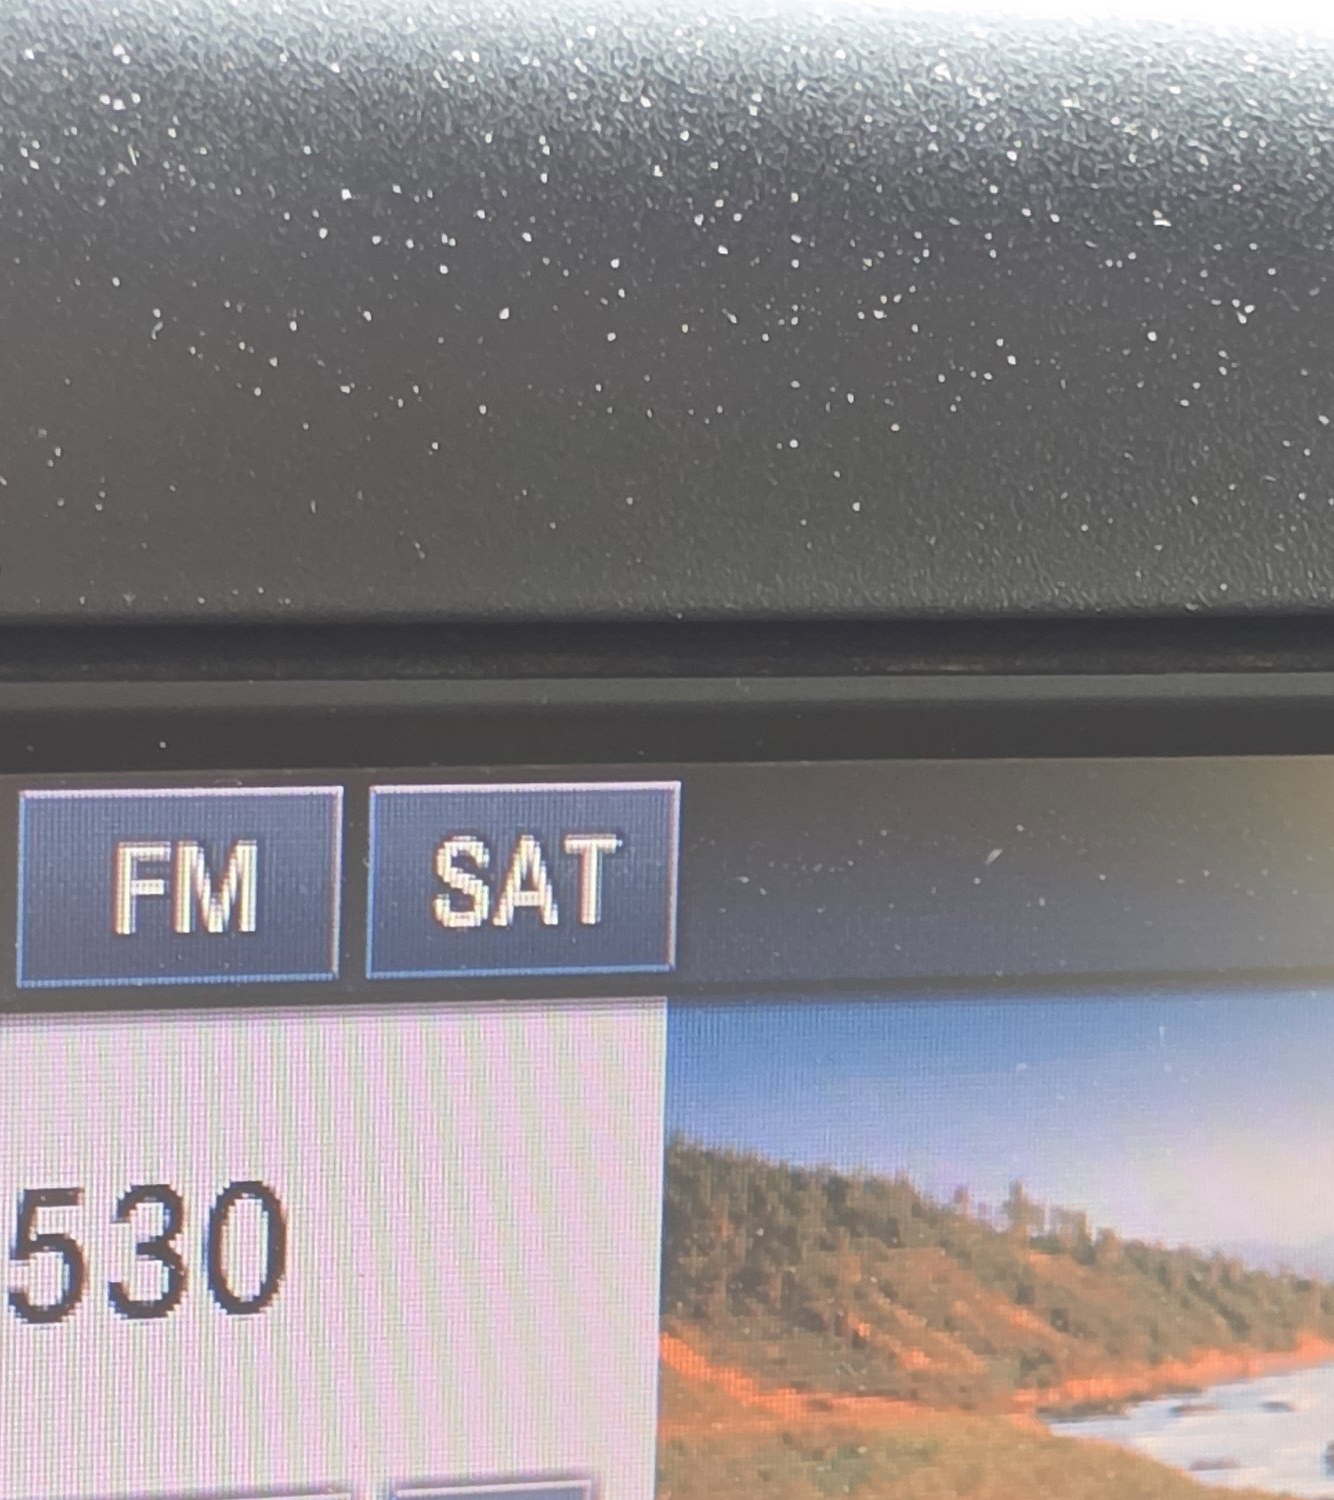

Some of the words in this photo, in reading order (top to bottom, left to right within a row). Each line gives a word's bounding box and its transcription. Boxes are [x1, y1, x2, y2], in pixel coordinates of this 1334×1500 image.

[112, 838, 261, 937] FM
[430, 832, 623, 929] SAT
[7, 1180, 289, 1325] 530
